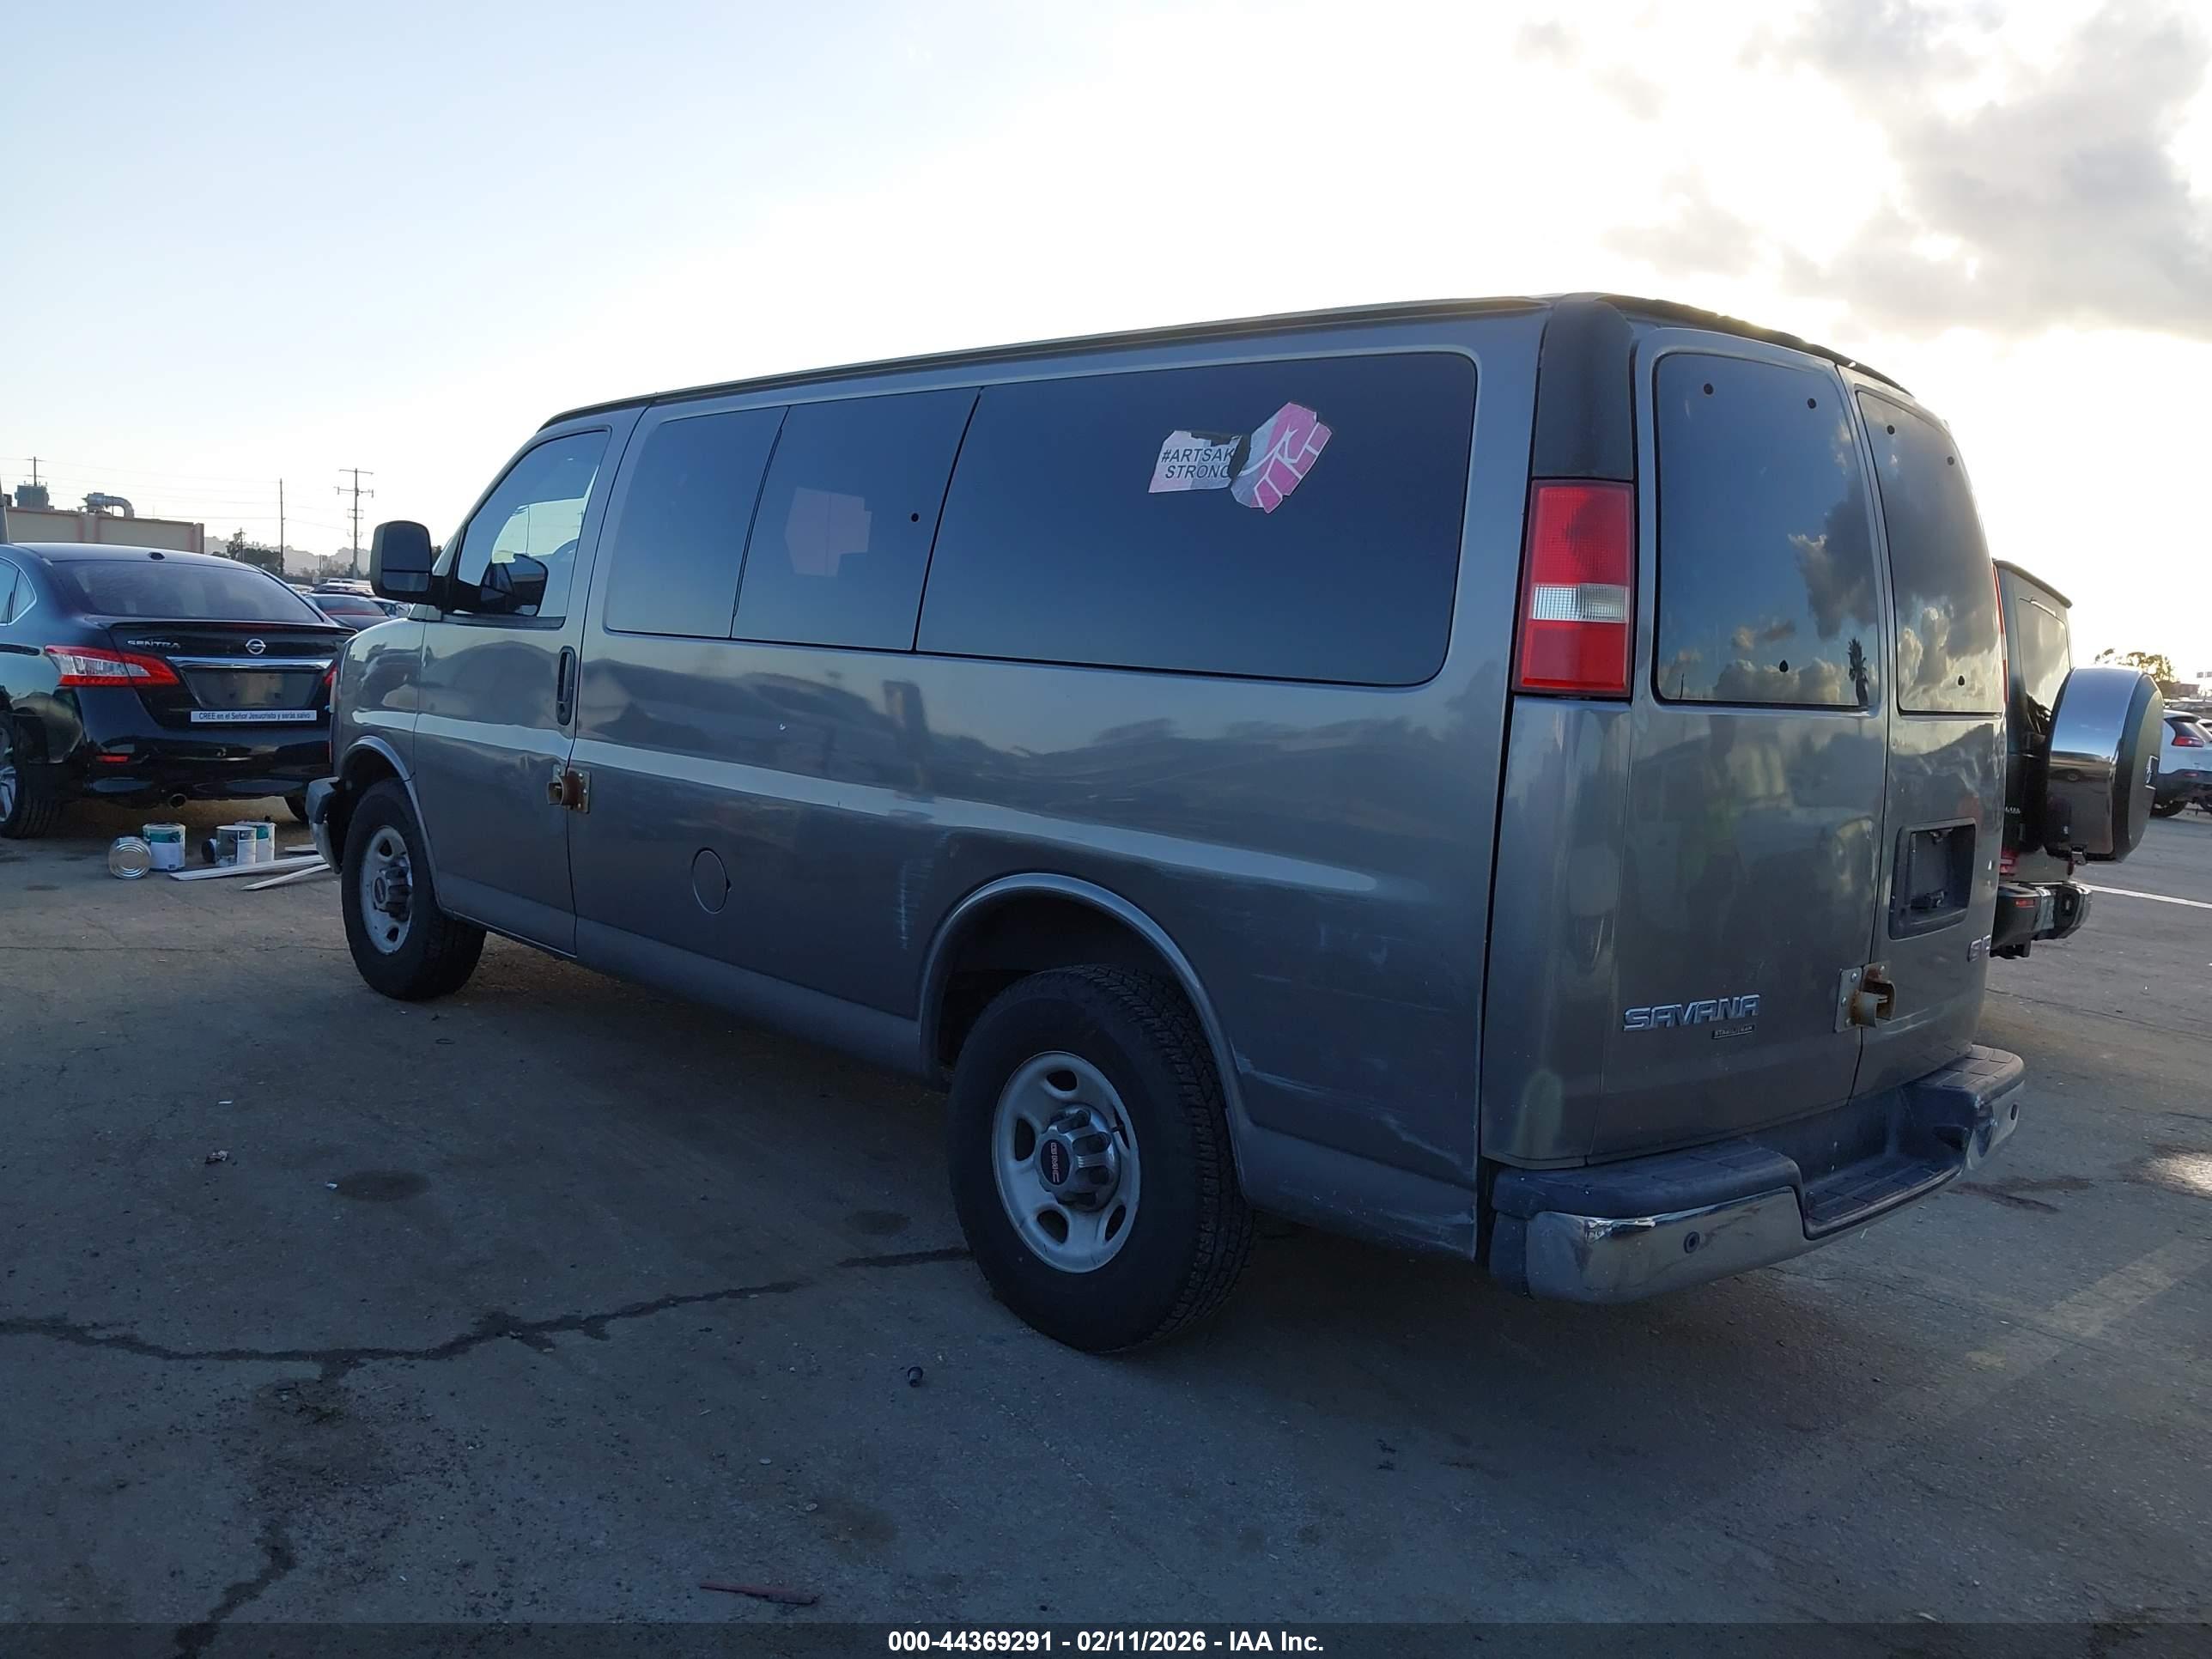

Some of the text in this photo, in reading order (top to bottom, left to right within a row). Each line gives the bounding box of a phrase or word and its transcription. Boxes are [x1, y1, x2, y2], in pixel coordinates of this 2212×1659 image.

[1161, 447, 1235, 463] #ARTSAK
[127, 640, 180, 649] SENTRA
[1623, 994, 1760, 1031] SAVANA
[1050, 1142, 1060, 1182] GMC
